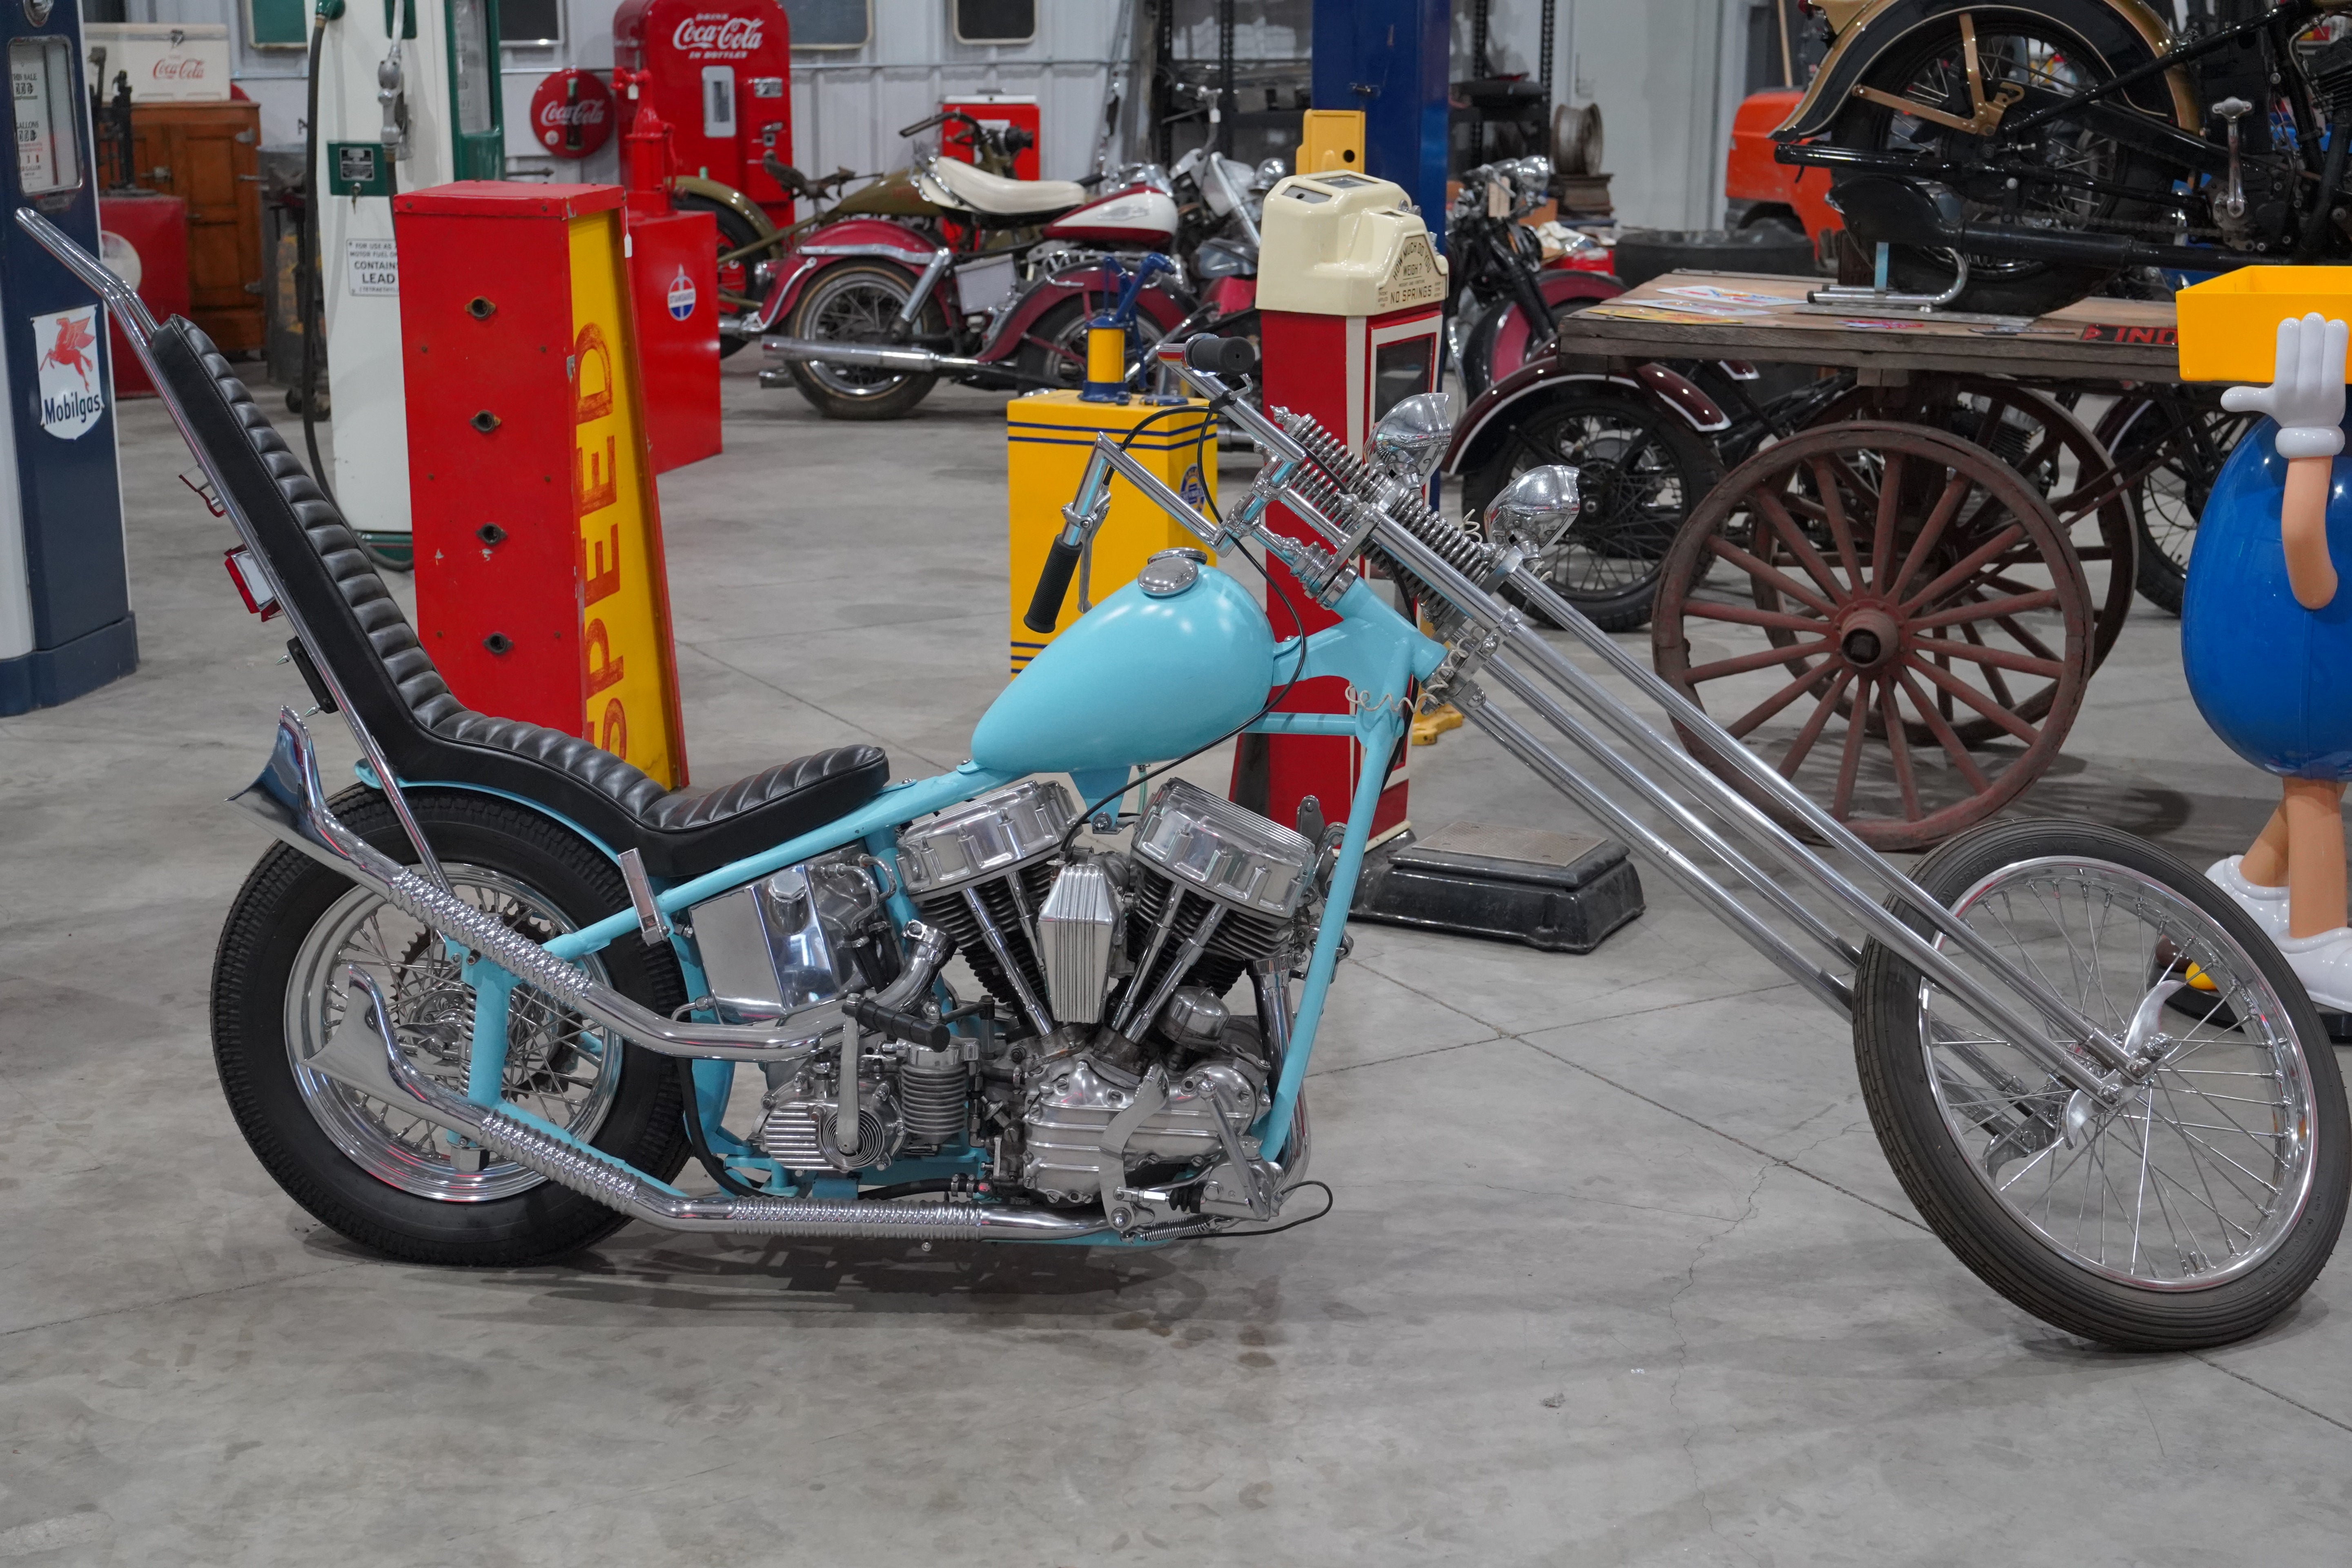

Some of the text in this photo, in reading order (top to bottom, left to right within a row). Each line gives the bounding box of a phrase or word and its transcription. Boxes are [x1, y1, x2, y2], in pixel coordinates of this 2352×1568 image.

[673, 18, 764, 50] Coca-Cola
[1393, 254, 1403, 281] HOW
[1403, 242, 1417, 259] MUCH
[362, 273, 395, 284] LEAD
[1390, 285, 1432, 304] NO SPRINGS
[44, 391, 100, 425] Mobilgas
[1959, 842, 2040, 887] SPEEDMASTER
